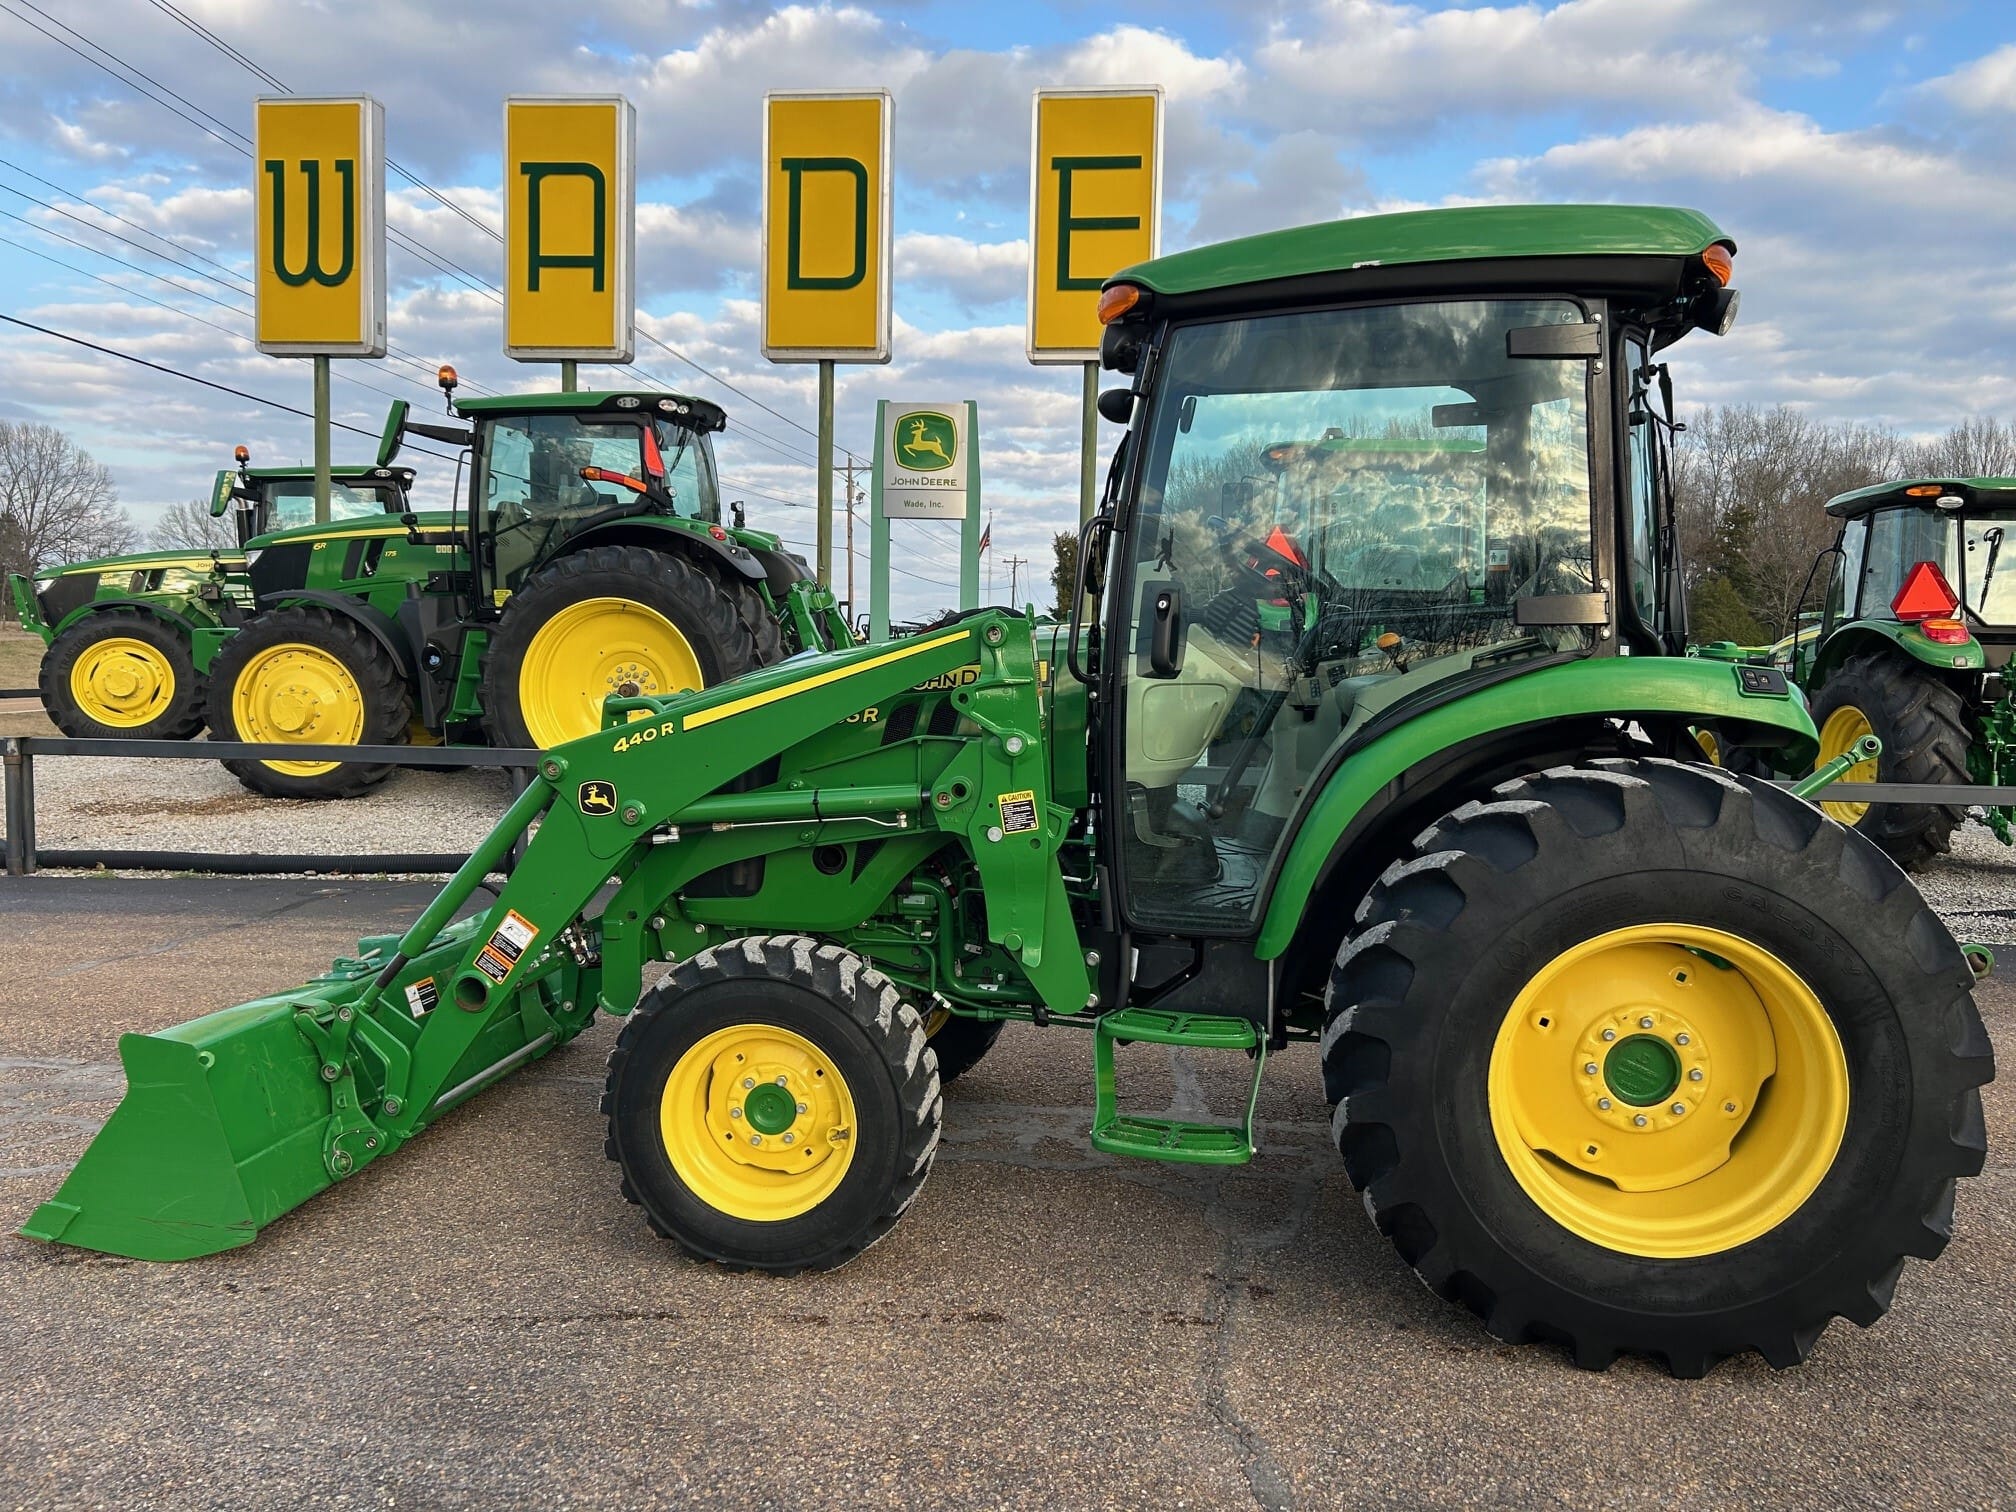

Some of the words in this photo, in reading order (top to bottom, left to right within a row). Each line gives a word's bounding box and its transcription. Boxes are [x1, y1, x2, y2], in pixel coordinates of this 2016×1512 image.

[890, 476, 919, 486] JOHN
[921, 476, 958, 487] DEERE
[903, 500, 927, 509] Wade,
[929, 500, 944, 508] Inc.
[1008, 792, 1032, 801] CAUTION
